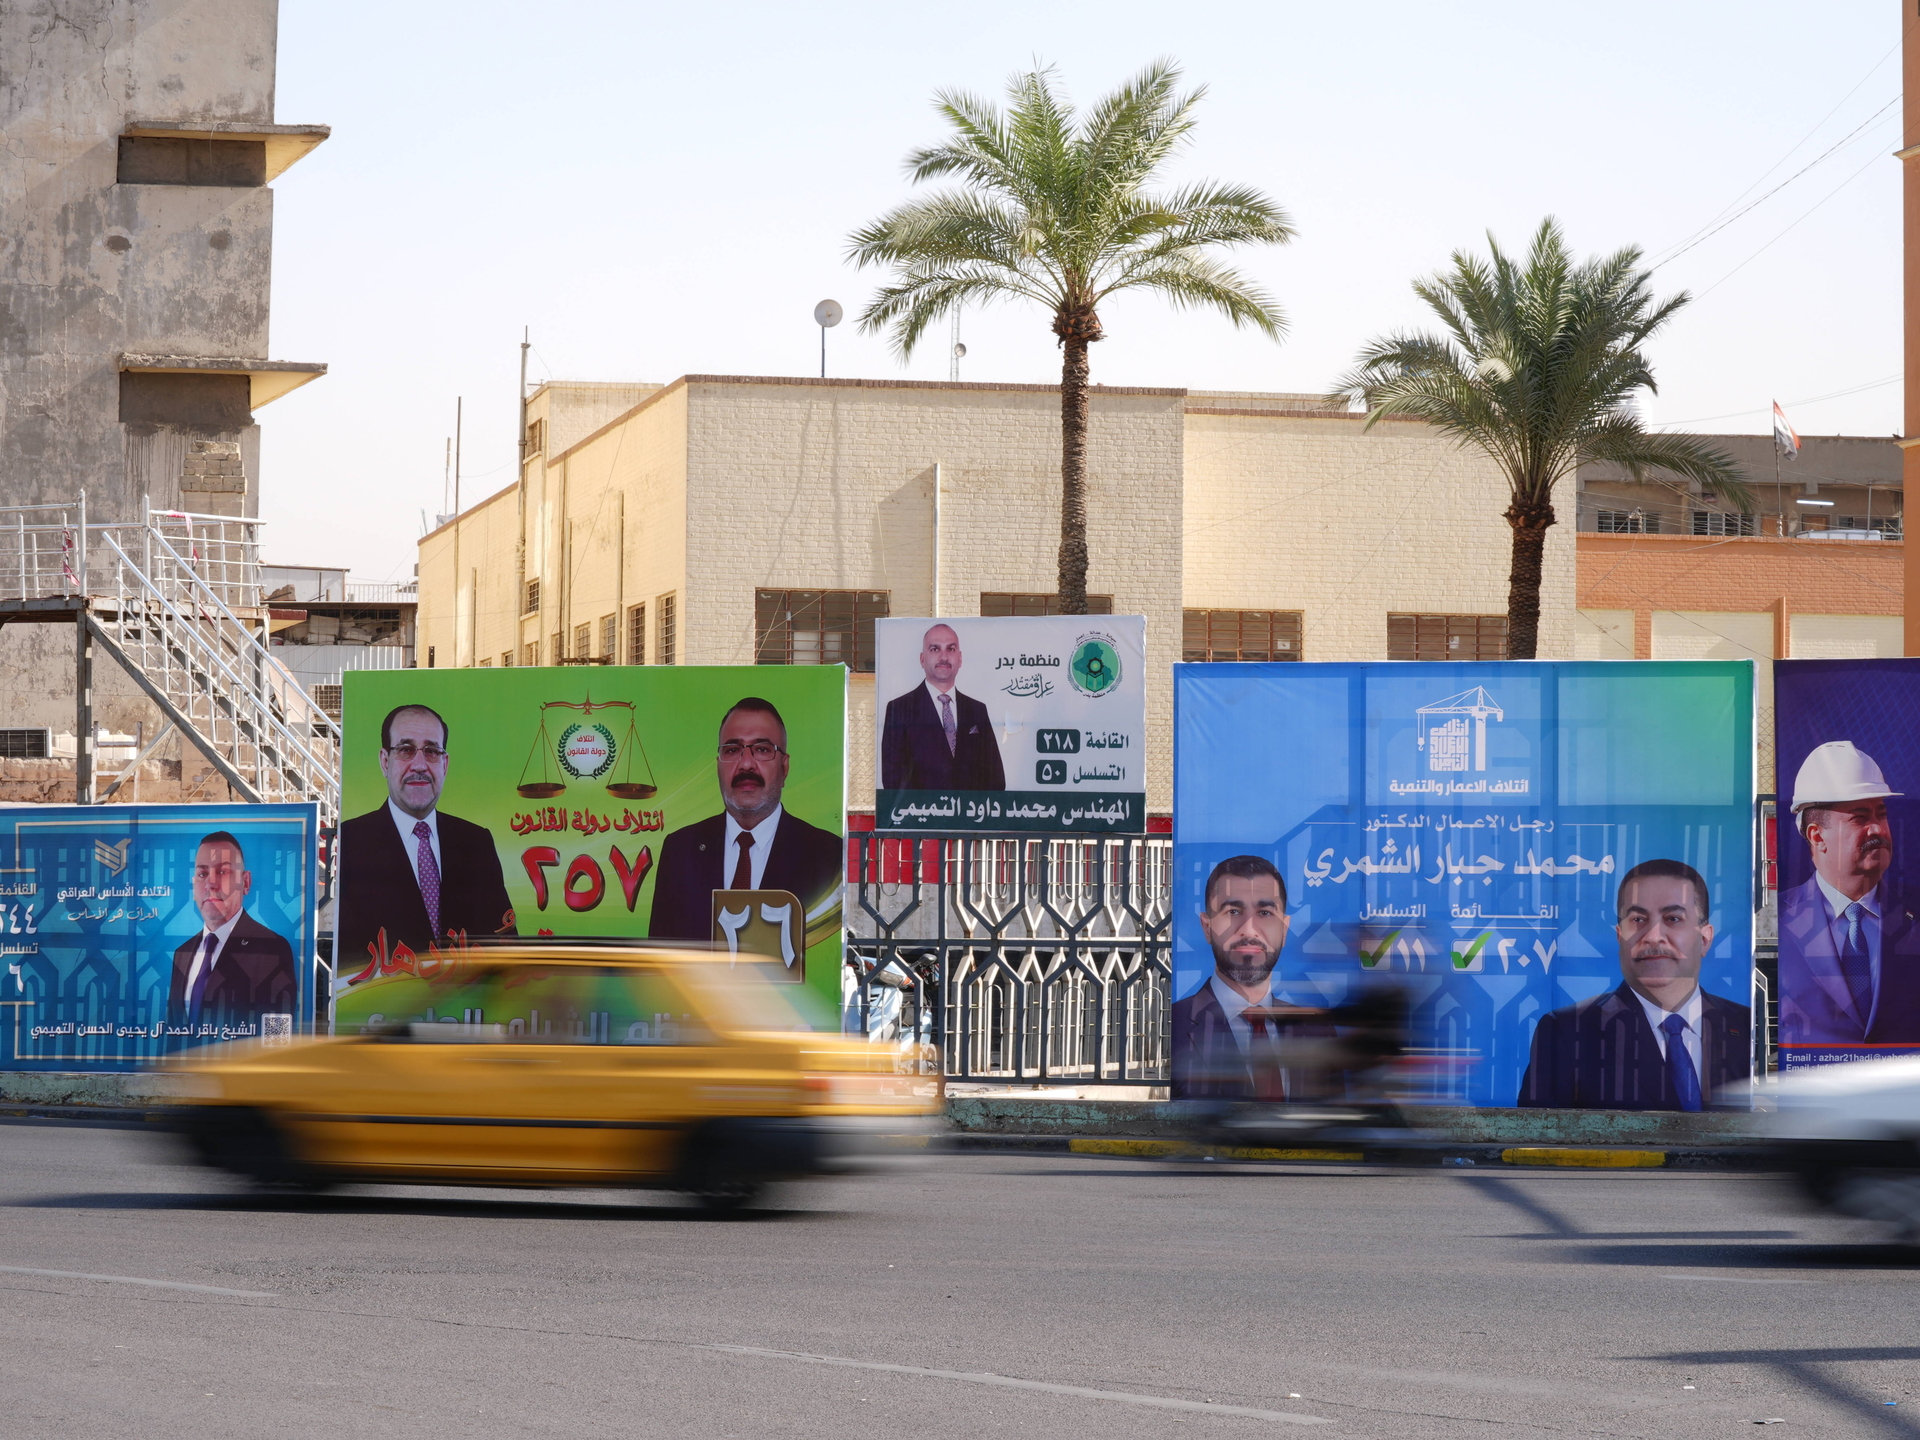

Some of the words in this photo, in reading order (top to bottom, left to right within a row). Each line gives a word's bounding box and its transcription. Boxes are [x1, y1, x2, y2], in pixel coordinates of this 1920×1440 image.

[995, 657, 1015, 670] بدر
[1019, 654, 1060, 667] منظمة
[576, 735, 595, 743] ائتلاف
[1043, 732, 1074, 751] ٢١٨
[1085, 732, 1129, 750] القائمة
[566, 748, 590, 757] القانون
[590, 748, 606, 757] دولة
[1041, 763, 1062, 781] ٥٠
[1073, 764, 1126, 784] التسلسل
[1389, 780, 1444, 796] والتنمية
[1445, 780, 1487, 796] الاعمار
[1488, 779, 1529, 793] ائتلاف
[890, 796, 961, 826] التميمي
[966, 797, 1001, 823] داود
[1006, 800, 1057, 819] محمد
[1062, 798, 1130, 826] المهندس
[510, 807, 568, 836] القانون
[571, 807, 610, 836] دولة
[613, 808, 665, 835] ائتلاف
[1362, 813, 1430, 832] الدكتور
[1434, 814, 1505, 832] الاعمال
[1508, 816, 1555, 833] رجل
[1303, 838, 1421, 888] الشمري
[1424, 843, 1506, 886] جبار
[1513, 848, 1616, 876] محمد
[519, 844, 654, 913] ٢٥٧
[57, 886, 95, 902] العراقي
[97, 882, 134, 900] الأساس
[137, 885, 171, 897] ائتلاف
[108, 908, 124, 923] هو
[126, 906, 159, 921] العراق
[1359, 903, 1427, 921] التسلسل
[717, 902, 796, 970] ٢٦
[1397, 938, 1427, 973] ١١
[1497, 938, 1559, 975] ٢٠٧
[8, 963, 24, 993] ٦
[30, 1022, 74, 1040] التميمي
[77, 1022, 113, 1038] الحسن
[116, 1026, 147, 1040] يحيى
[150, 1020, 164, 1039] آل
[166, 1023, 194, 1036] احمد
[196, 1023, 218, 1039] باقر
[221, 1021, 257, 1040] الشيخ
[1786, 1053, 1811, 1062] Email
[1786, 1063, 1810, 1072] Email
